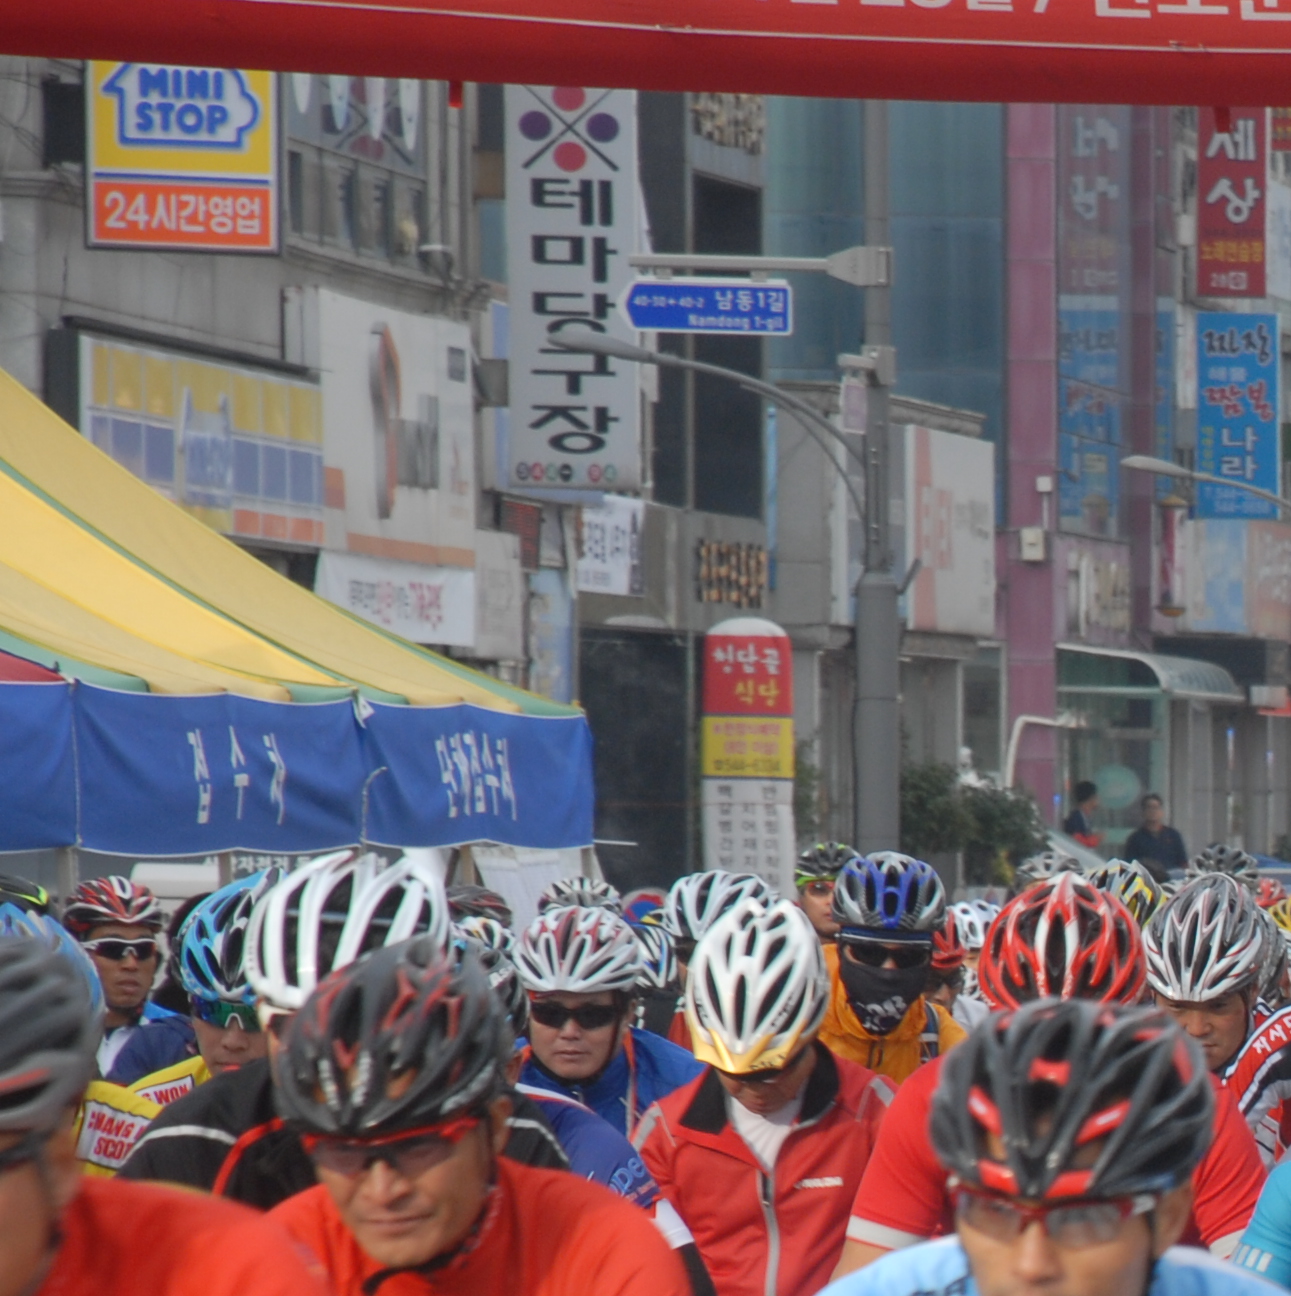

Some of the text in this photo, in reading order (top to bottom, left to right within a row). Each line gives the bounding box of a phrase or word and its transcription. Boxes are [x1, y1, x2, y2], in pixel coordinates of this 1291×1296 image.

[139, 67, 224, 100] MINI
[135, 101, 229, 135] STOP
[1205, 118, 1260, 224] 세상
[104, 190, 261, 235] 24시간영업
[528, 176, 620, 455] 테마당구장
[714, 290, 785, 313] 남동1길
[688, 314, 749, 331] Namdong
[1219, 425, 1259, 480] 나라
[735, 677, 780, 707] 식당
